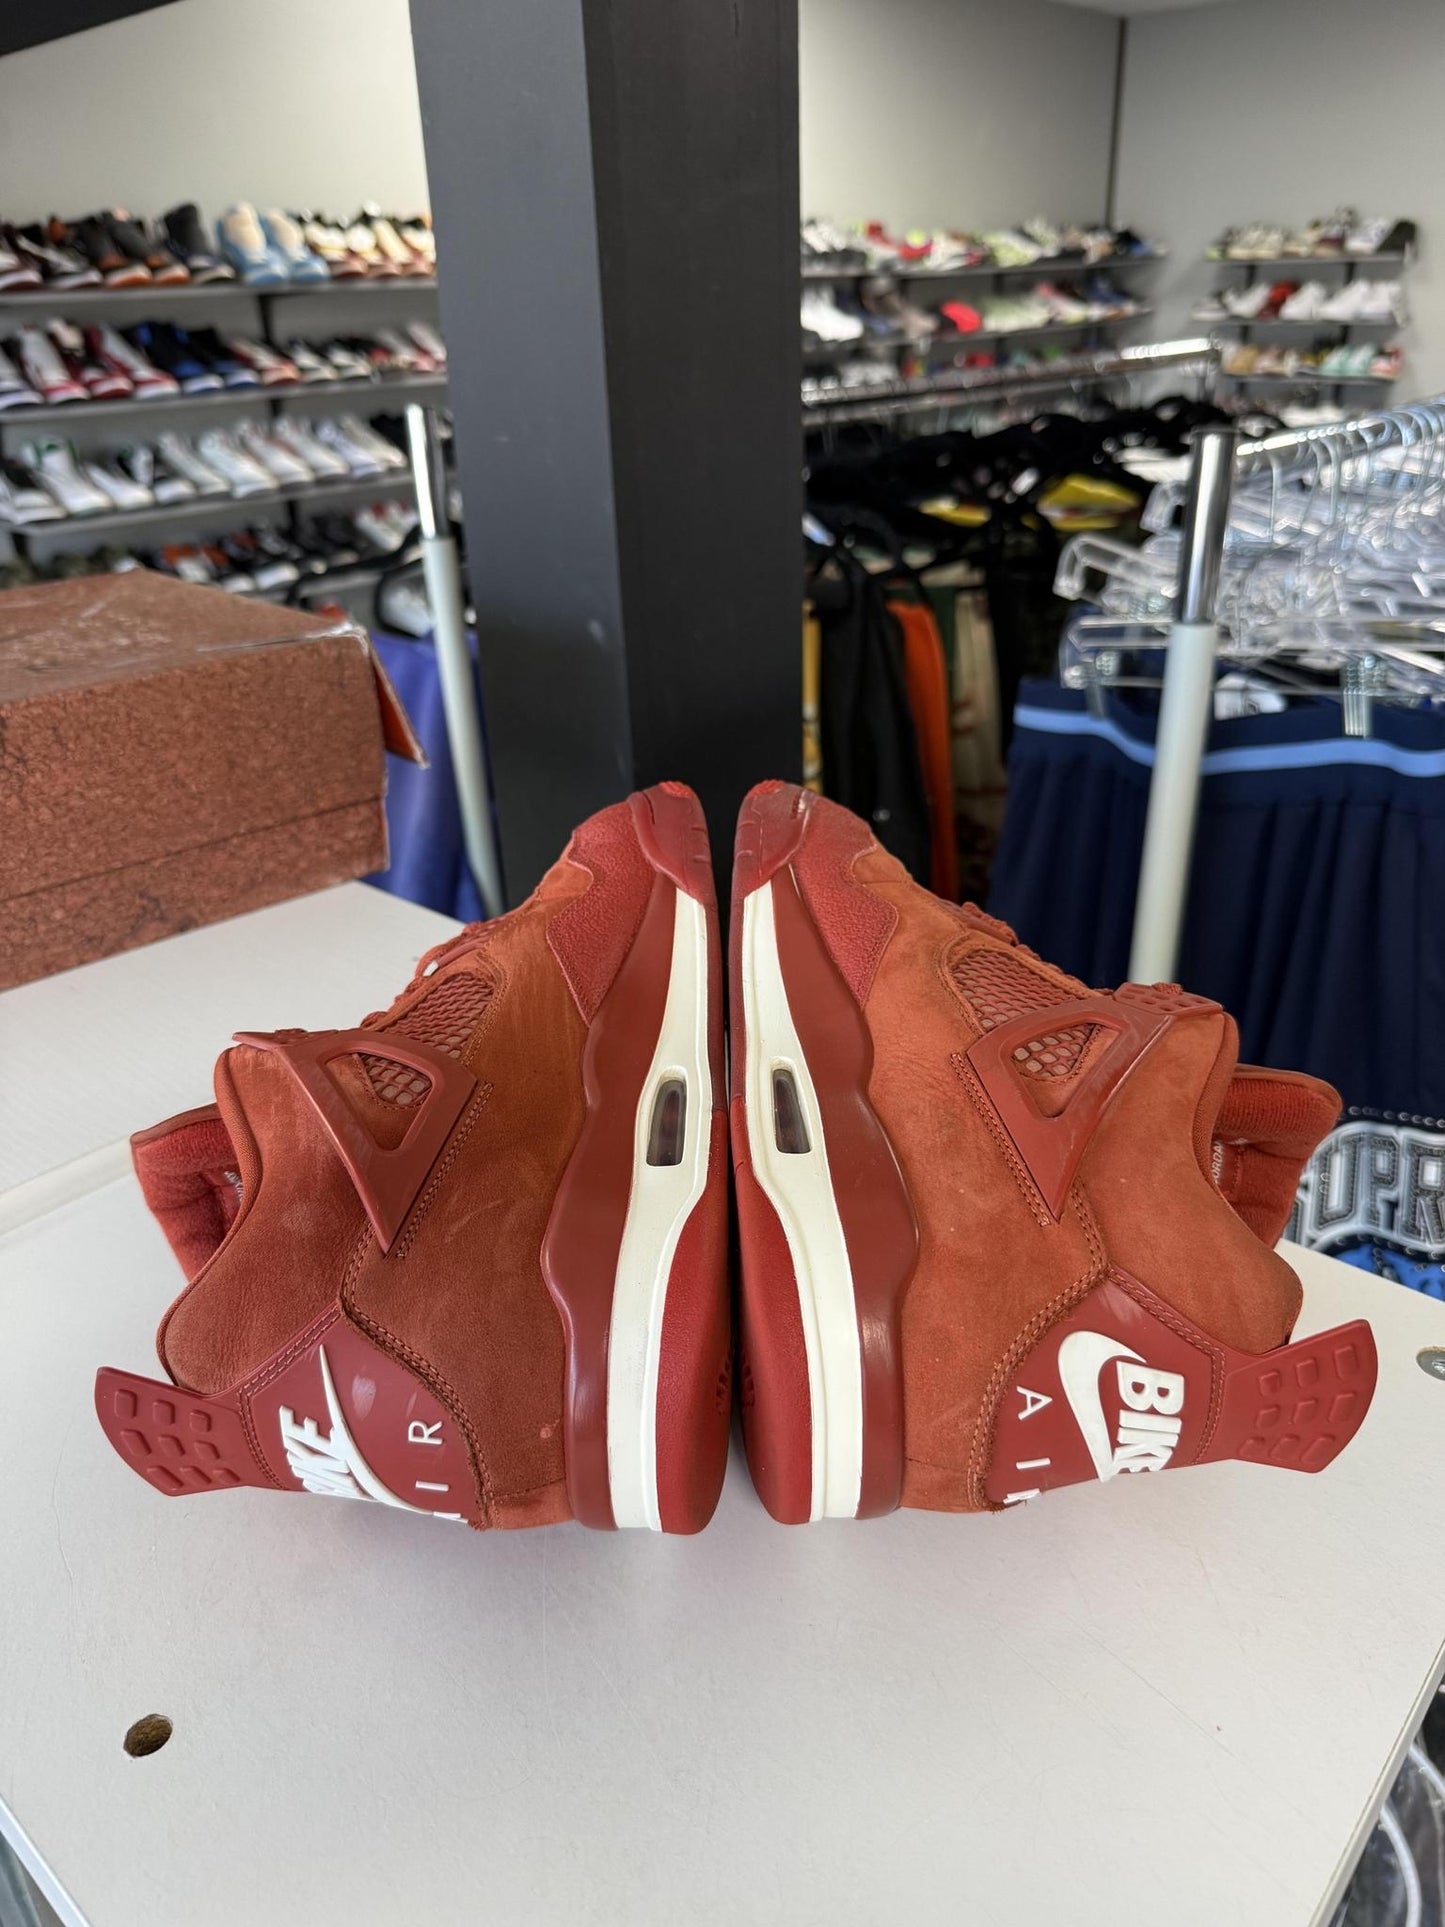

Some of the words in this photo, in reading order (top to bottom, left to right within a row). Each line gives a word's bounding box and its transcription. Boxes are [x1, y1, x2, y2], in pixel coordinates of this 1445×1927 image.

[1211, 1140, 1225, 1184] ORDA
[1284, 1122, 1445, 1254] UPR
[407, 1421, 468, 1524] IR
[1003, 1386, 1053, 1504] AI
